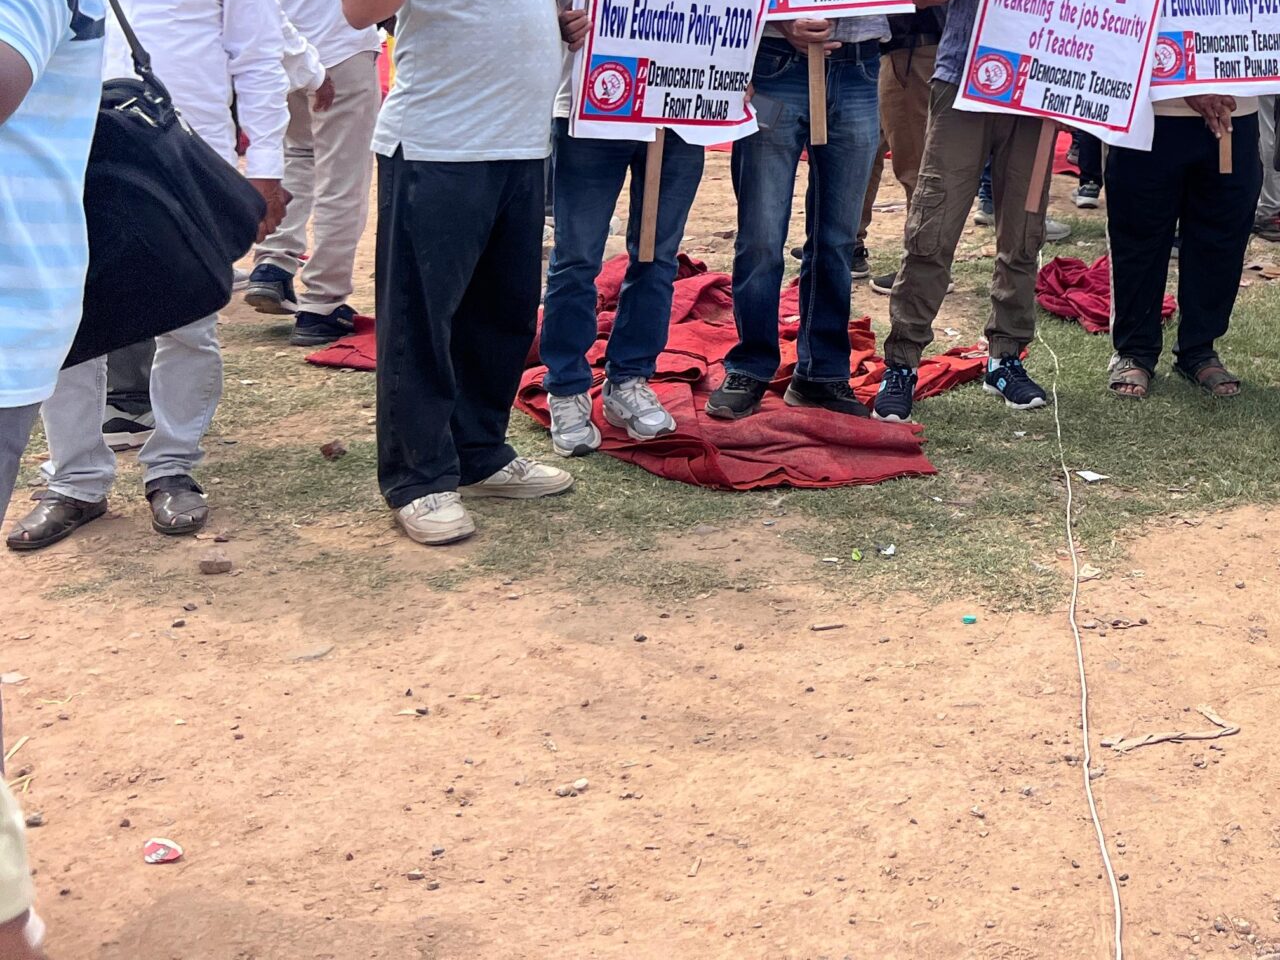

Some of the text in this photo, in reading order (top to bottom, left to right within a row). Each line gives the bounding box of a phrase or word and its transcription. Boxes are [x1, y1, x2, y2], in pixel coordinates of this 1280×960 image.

[687, 3, 753, 56] Policy-2020
[1060, 0, 1076, 24] the
[1077, 3, 1099, 30] job
[1100, 8, 1147, 43] Security
[1029, 27, 1095, 62] of Teachers
[1195, 31, 1249, 54] DEMOCRATIC
[647, 61, 705, 90] DEMOCRATIC
[708, 65, 750, 92] TEACHERS
[1029, 58, 1086, 91] DEMOCRATIC
[1088, 71, 1133, 101] TEACHERS
[1214, 55, 1278, 79] FRONT PUNJAB
[662, 92, 729, 120] FRONT PUNJAB
[1041, 87, 1110, 122] FRONT PUNJAB
